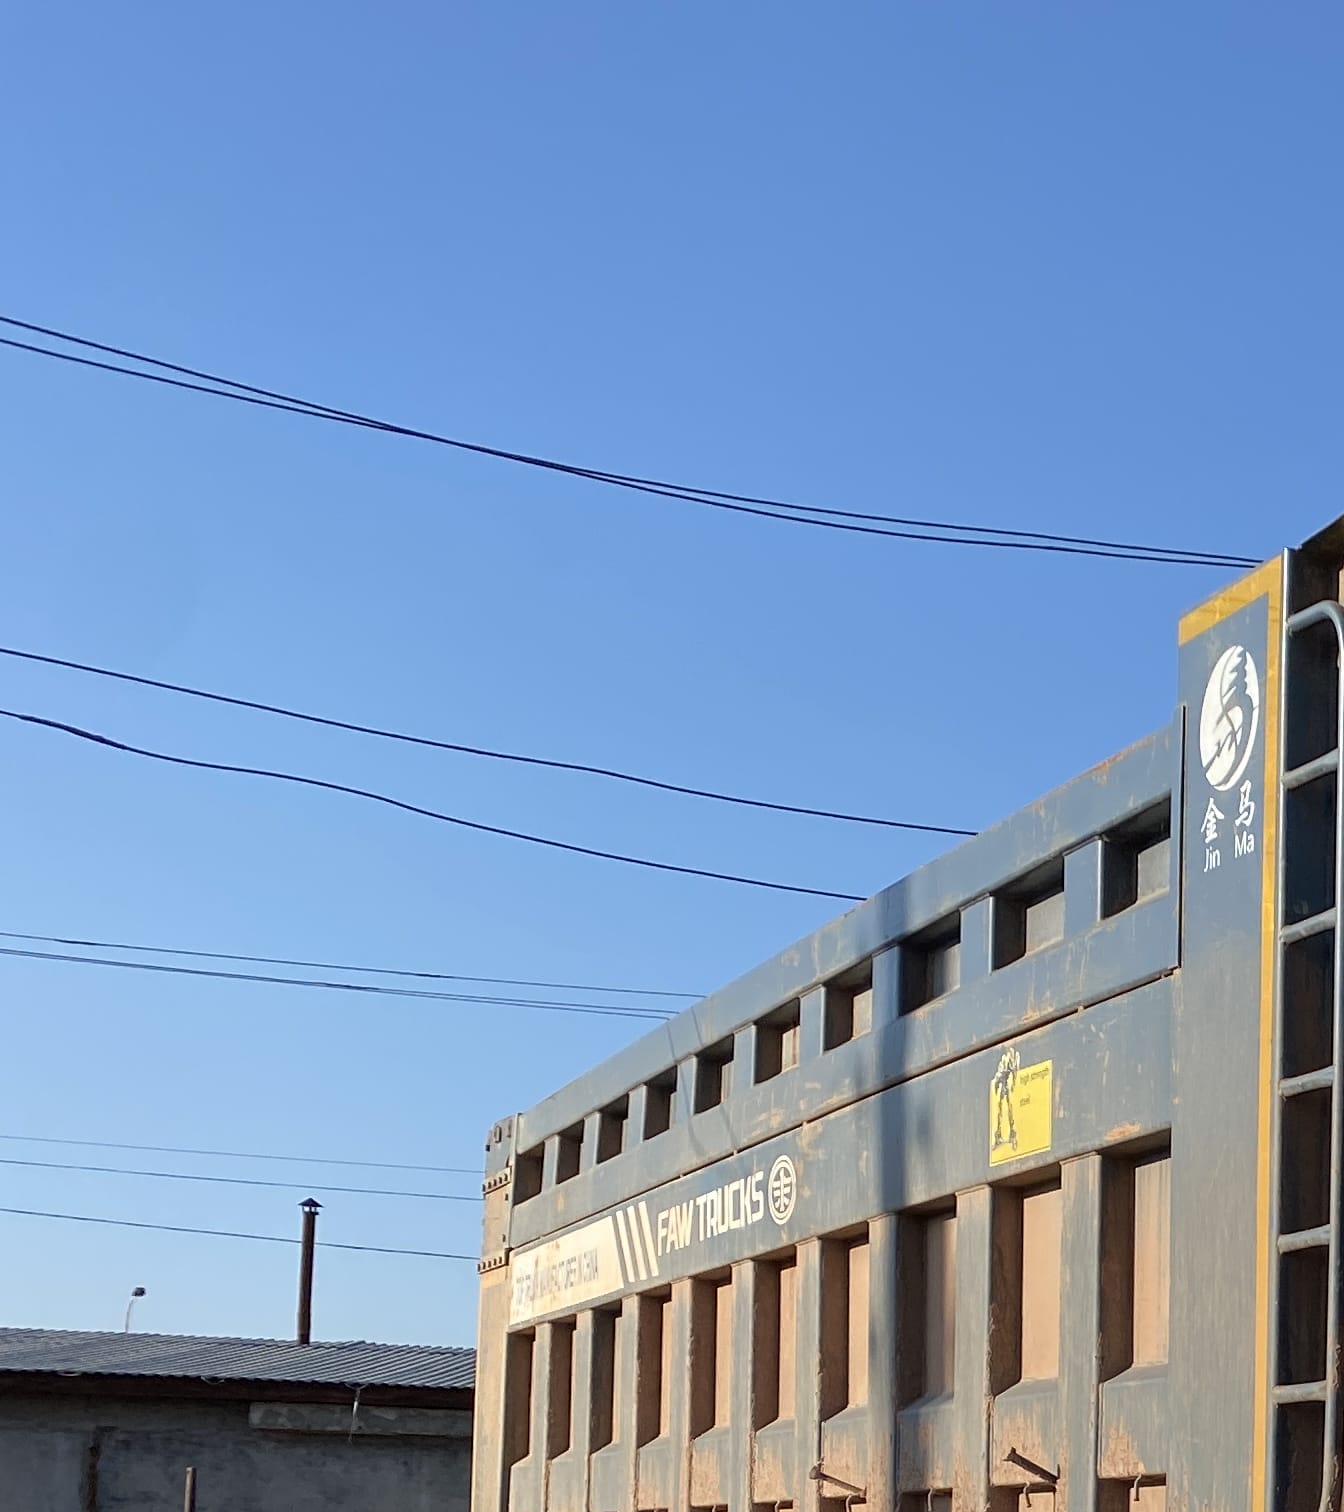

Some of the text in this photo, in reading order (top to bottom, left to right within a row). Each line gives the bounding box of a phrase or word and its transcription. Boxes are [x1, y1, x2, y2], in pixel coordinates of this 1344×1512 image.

[1200, 779, 1256, 844] 金马
[1203, 830, 1255, 873] Jin Ma
[656, 1170, 765, 1257] FAW TRUCKS
